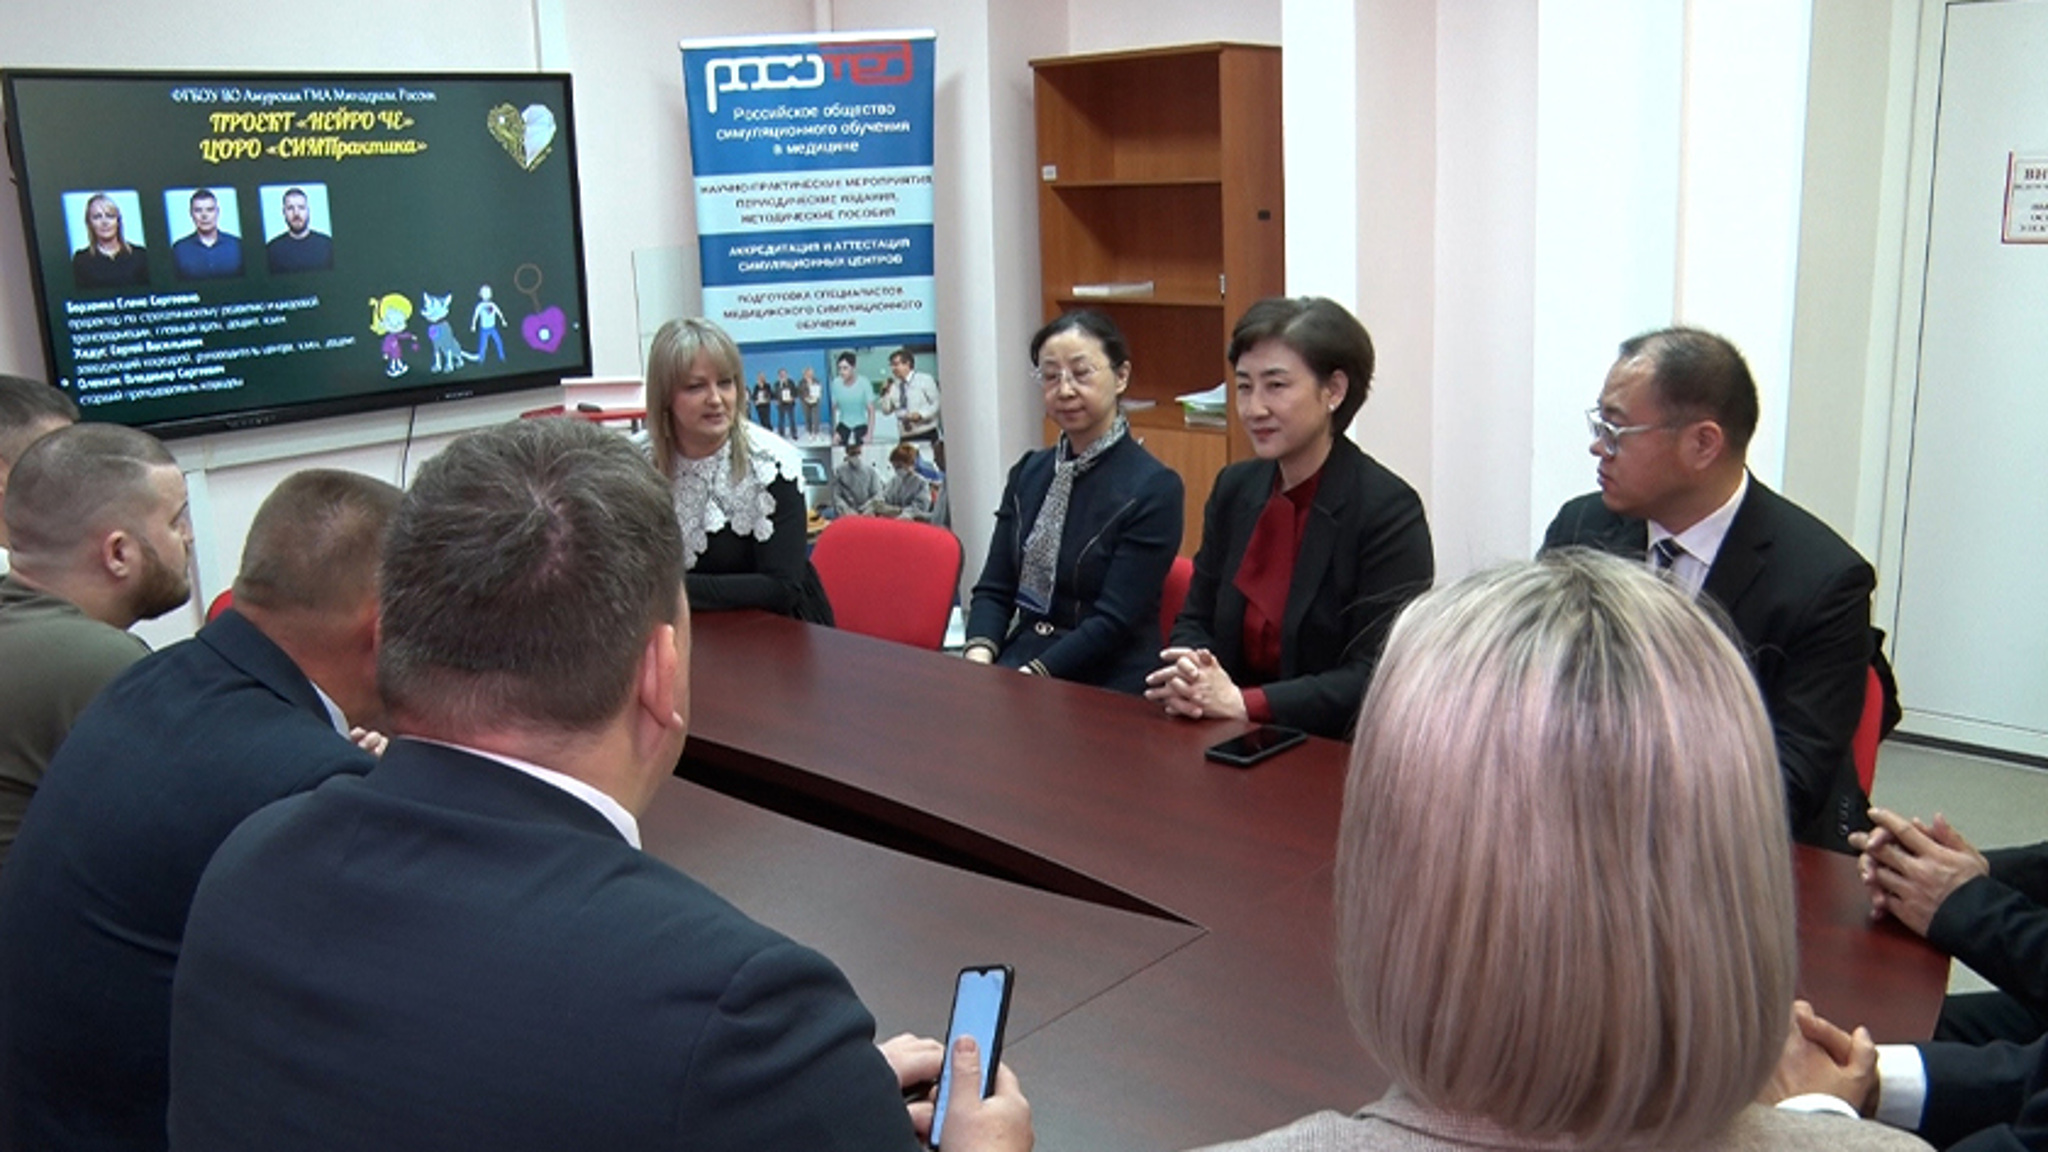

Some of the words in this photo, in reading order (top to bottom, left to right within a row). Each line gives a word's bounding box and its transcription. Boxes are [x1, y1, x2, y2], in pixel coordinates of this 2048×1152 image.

[733, 105, 818, 121] Российское
[823, 102, 896, 119] общество
[209, 110, 297, 133] ПРОЕКТ
[716, 121, 837, 141] симуляционного
[841, 119, 911, 137] обучения
[199, 137, 262, 164] ЦОРО
[773, 145, 783, 155] в
[786, 141, 859, 157] медицине
[700, 179, 842, 195] НАУЧНО-ПРАКТИЧЕСКИЕ
[736, 195, 836, 209] ПЕРИОДИЧЕСКИЕ
[741, 211, 835, 225] МЕТОДИЧЕСКИЕ
[838, 207, 895, 219] ПОСОБИЯ
[728, 242, 821, 258] АККРЕДИТАЦИЯ
[833, 237, 911, 252] АТТЕСТАЦИЯ
[738, 258, 845, 273] СИМУЛЯЦИОННЫХ
[848, 253, 903, 268] ЦЕНТРОВ
[738, 291, 812, 304] ПОДГОТОВКА
[814, 286, 904, 301] СПЕЦИАЛИСТОВ
[723, 306, 814, 320] МЕДИЦИНСКОГО
[816, 300, 923, 315] СИМУЛЯЦИОННОГО
[796, 319, 857, 331] ОБУЧЕНИЯ
